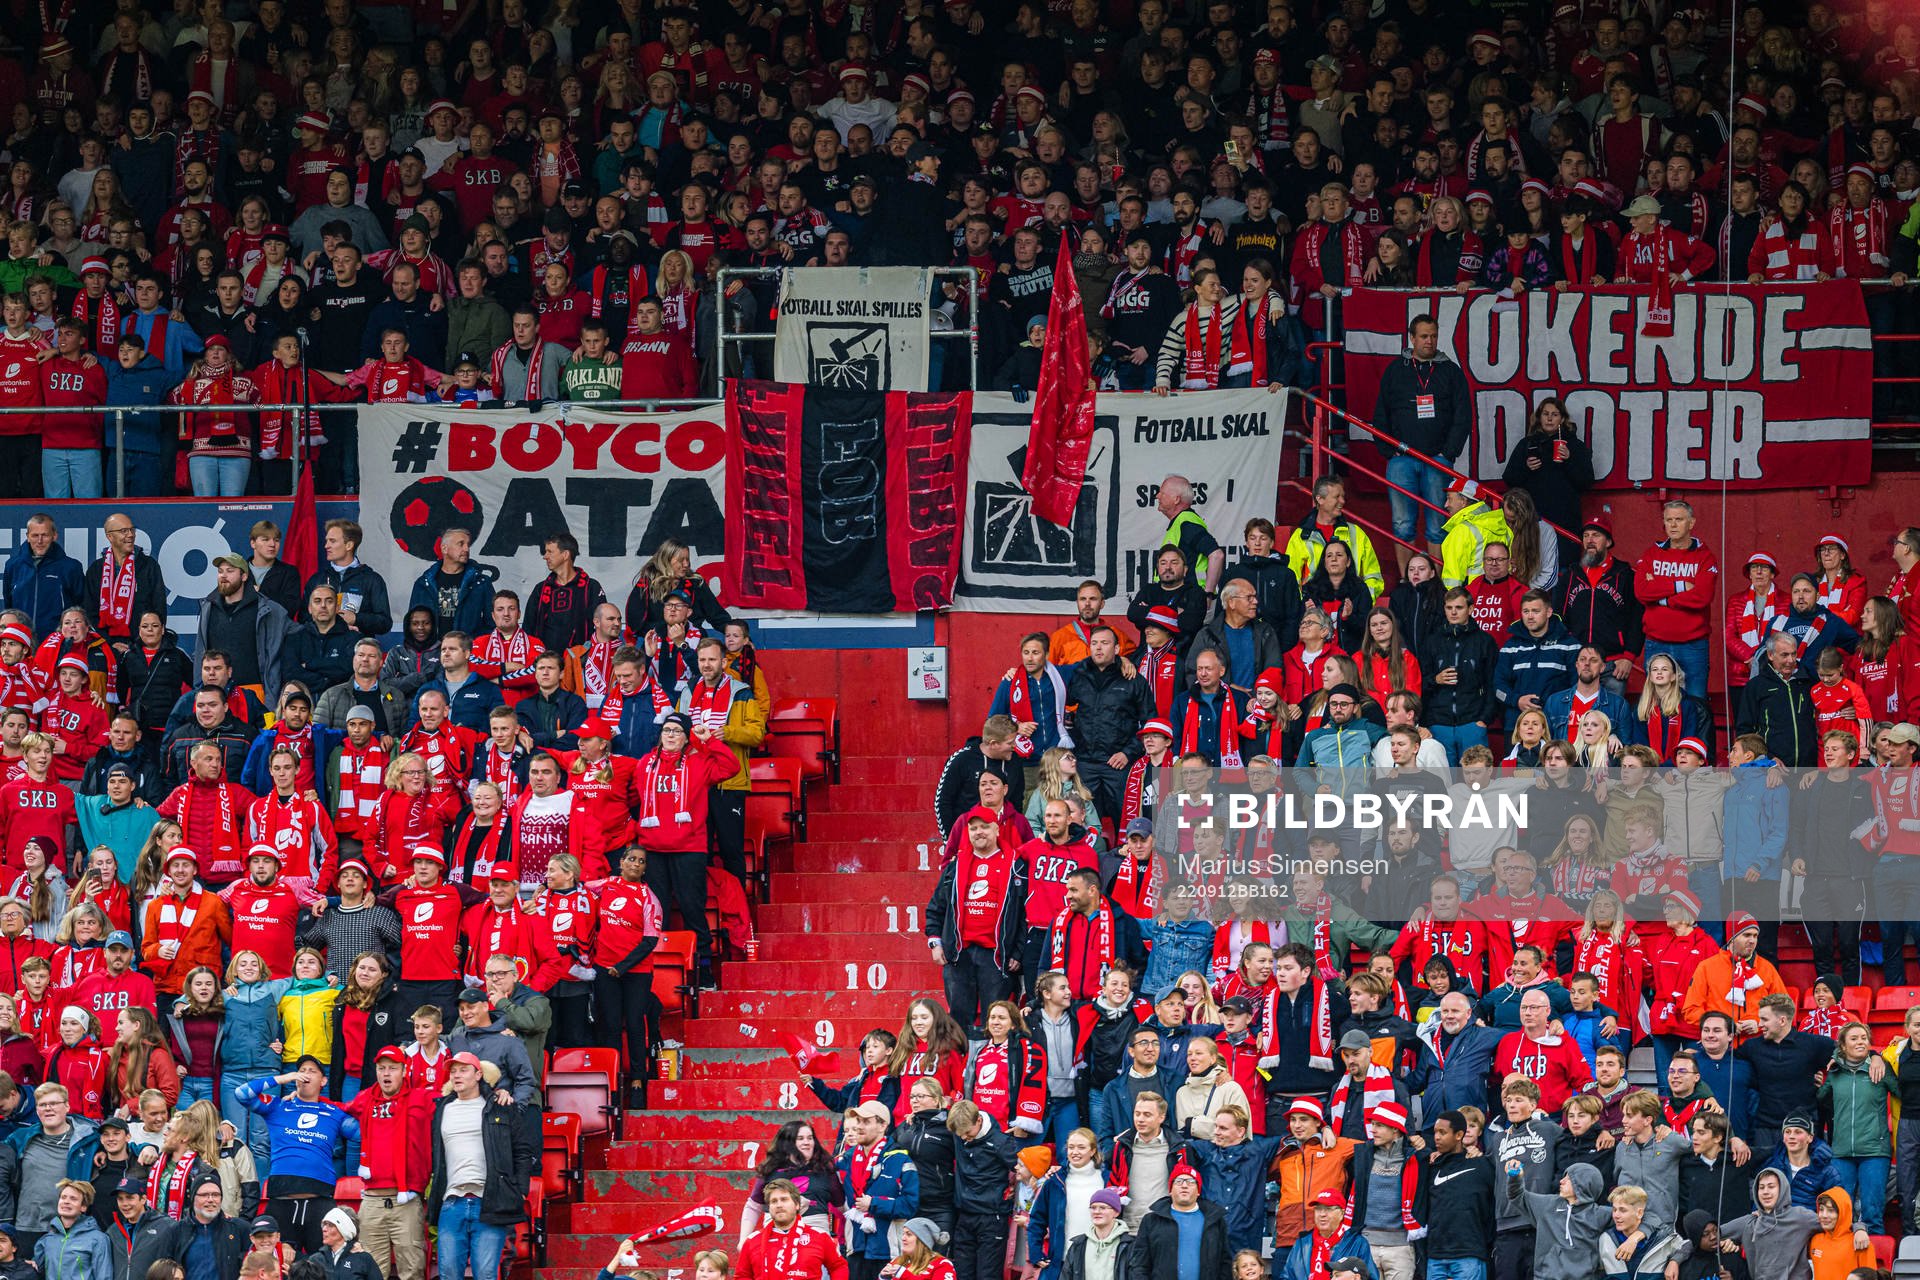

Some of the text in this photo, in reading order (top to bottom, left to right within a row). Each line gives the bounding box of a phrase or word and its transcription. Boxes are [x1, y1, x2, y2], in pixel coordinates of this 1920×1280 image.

[464, 169, 501, 185] SKB
[1235, 234, 1277, 251] THRASHER
[1009, 275, 1054, 297] YOUTH
[836, 299, 870, 317] SKAL
[872, 299, 923, 319] SPILLES
[1406, 291, 1804, 384] KOKENDE
[624, 341, 671, 355] BRANN
[50, 372, 84, 391] SKB
[1134, 411, 1270, 443] FOTBALL SKAL
[1455, 389, 1765, 482] DOTER
[392, 420, 726, 474] #BOYCO
[1652, 559, 1698, 578] BRANN
[1486, 594, 1502, 605] du
[571, 782, 612, 791] Sparebanken
[20, 790, 57, 808] SKB
[236, 913, 280, 924] Sparebanken
[248, 923, 265, 931] Vest
[886, 906, 920, 933] 11
[415, 932, 430, 940] Vest
[845, 963, 887, 990] 10
[94, 991, 129, 1012] SKB
[814, 1019, 835, 1047] 9
[1513, 1055, 1547, 1080] SKB
[778, 1081, 799, 1110] 8
[284, 1126, 328, 1141] Sparebanken
[298, 1135, 313, 1144] Vest
[742, 1141, 760, 1169] 7
